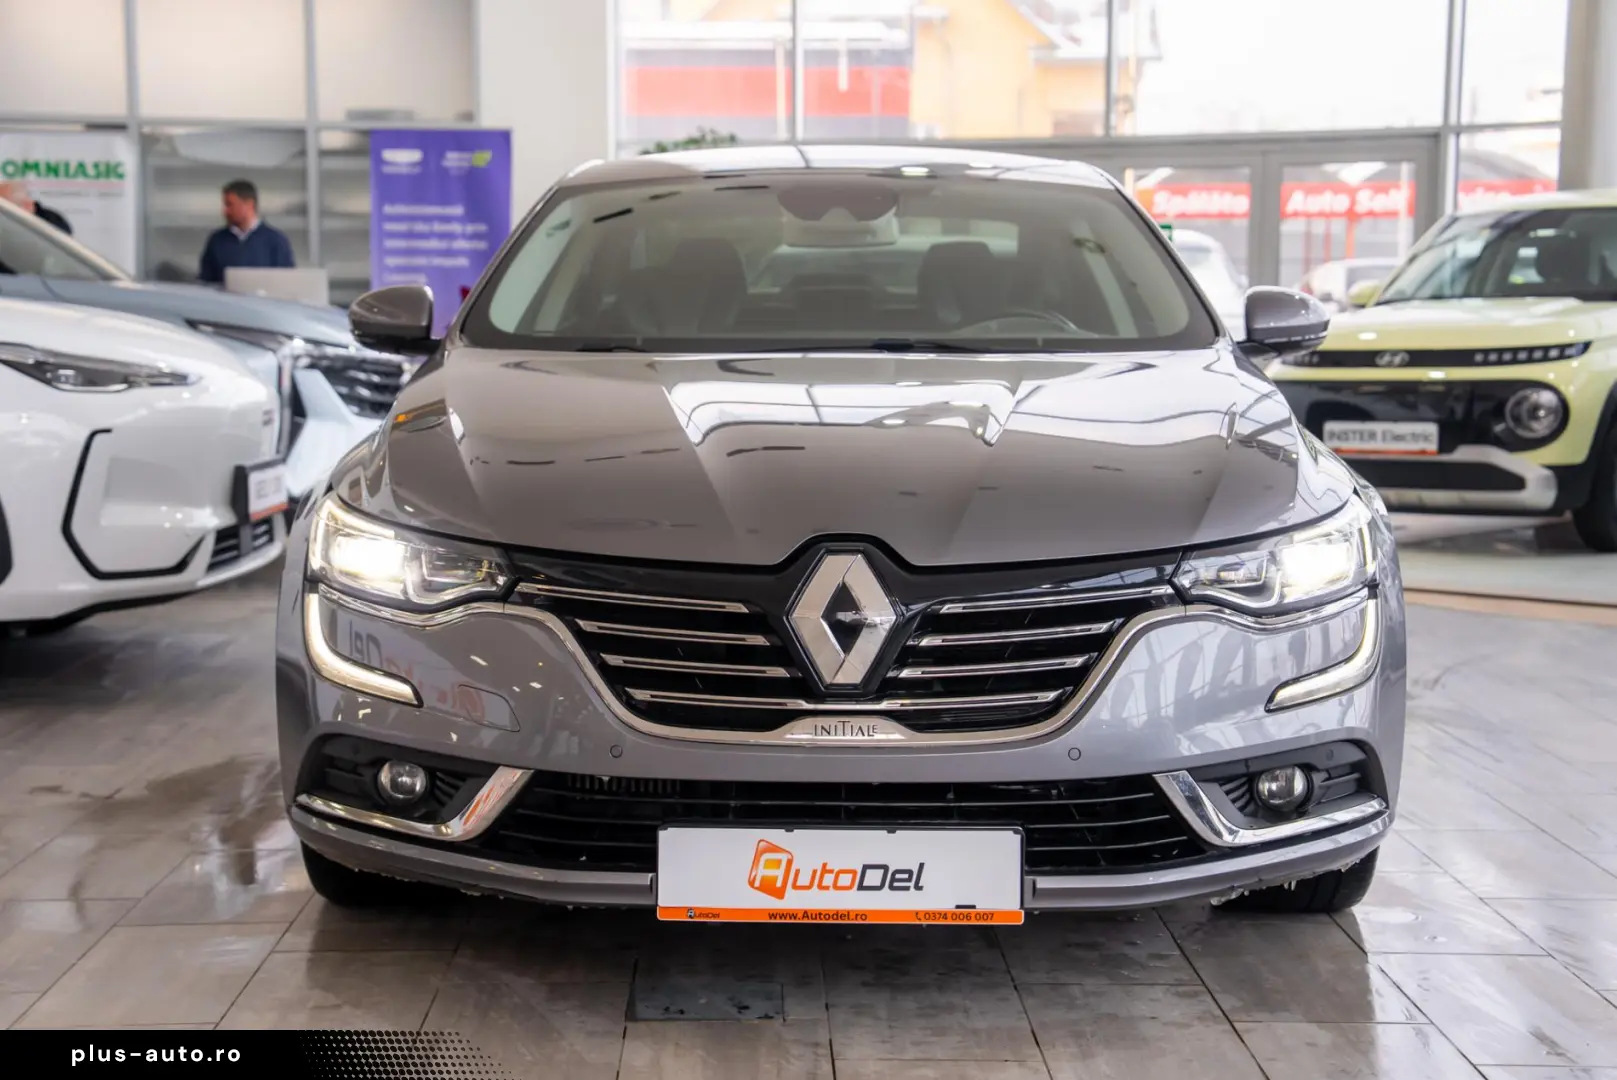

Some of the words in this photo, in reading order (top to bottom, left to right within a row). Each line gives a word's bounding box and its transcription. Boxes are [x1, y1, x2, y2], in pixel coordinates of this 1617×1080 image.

[1, 160, 125, 180] OMNIASIG
[1285, 189, 1350, 214] Auto
[1381, 429, 1434, 443] Electric
[814, 720, 878, 737] INITIALE
[749, 844, 925, 895] AutoDel
[768, 910, 868, 921] www.Autodel.ro
[923, 910, 948, 921] 0374
[951, 911, 972, 921] 006
[974, 911, 995, 921] 007
